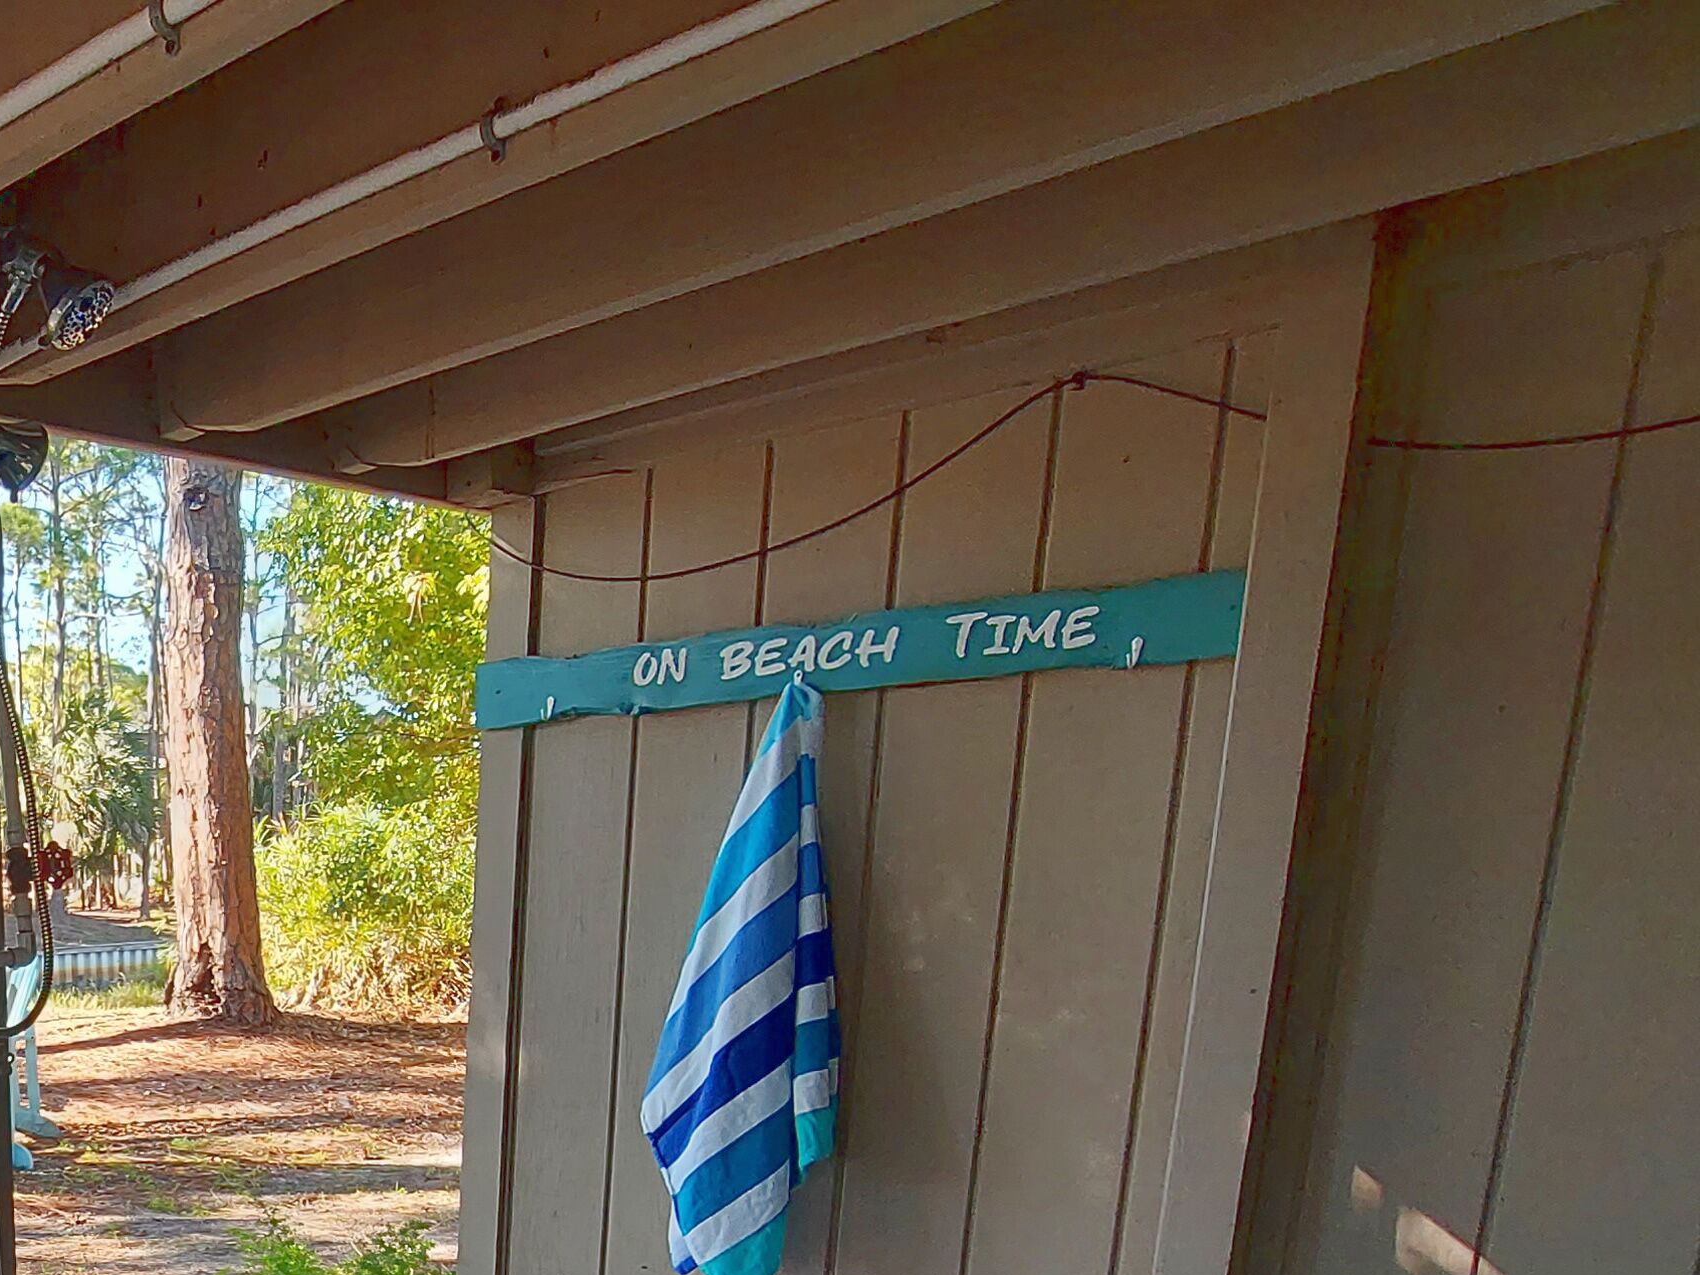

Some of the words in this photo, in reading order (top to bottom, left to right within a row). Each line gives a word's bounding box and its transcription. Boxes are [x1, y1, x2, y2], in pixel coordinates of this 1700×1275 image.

[633, 648, 687, 686] ON
[719, 627, 900, 680] BEACH
[945, 605, 1100, 658] TIME
